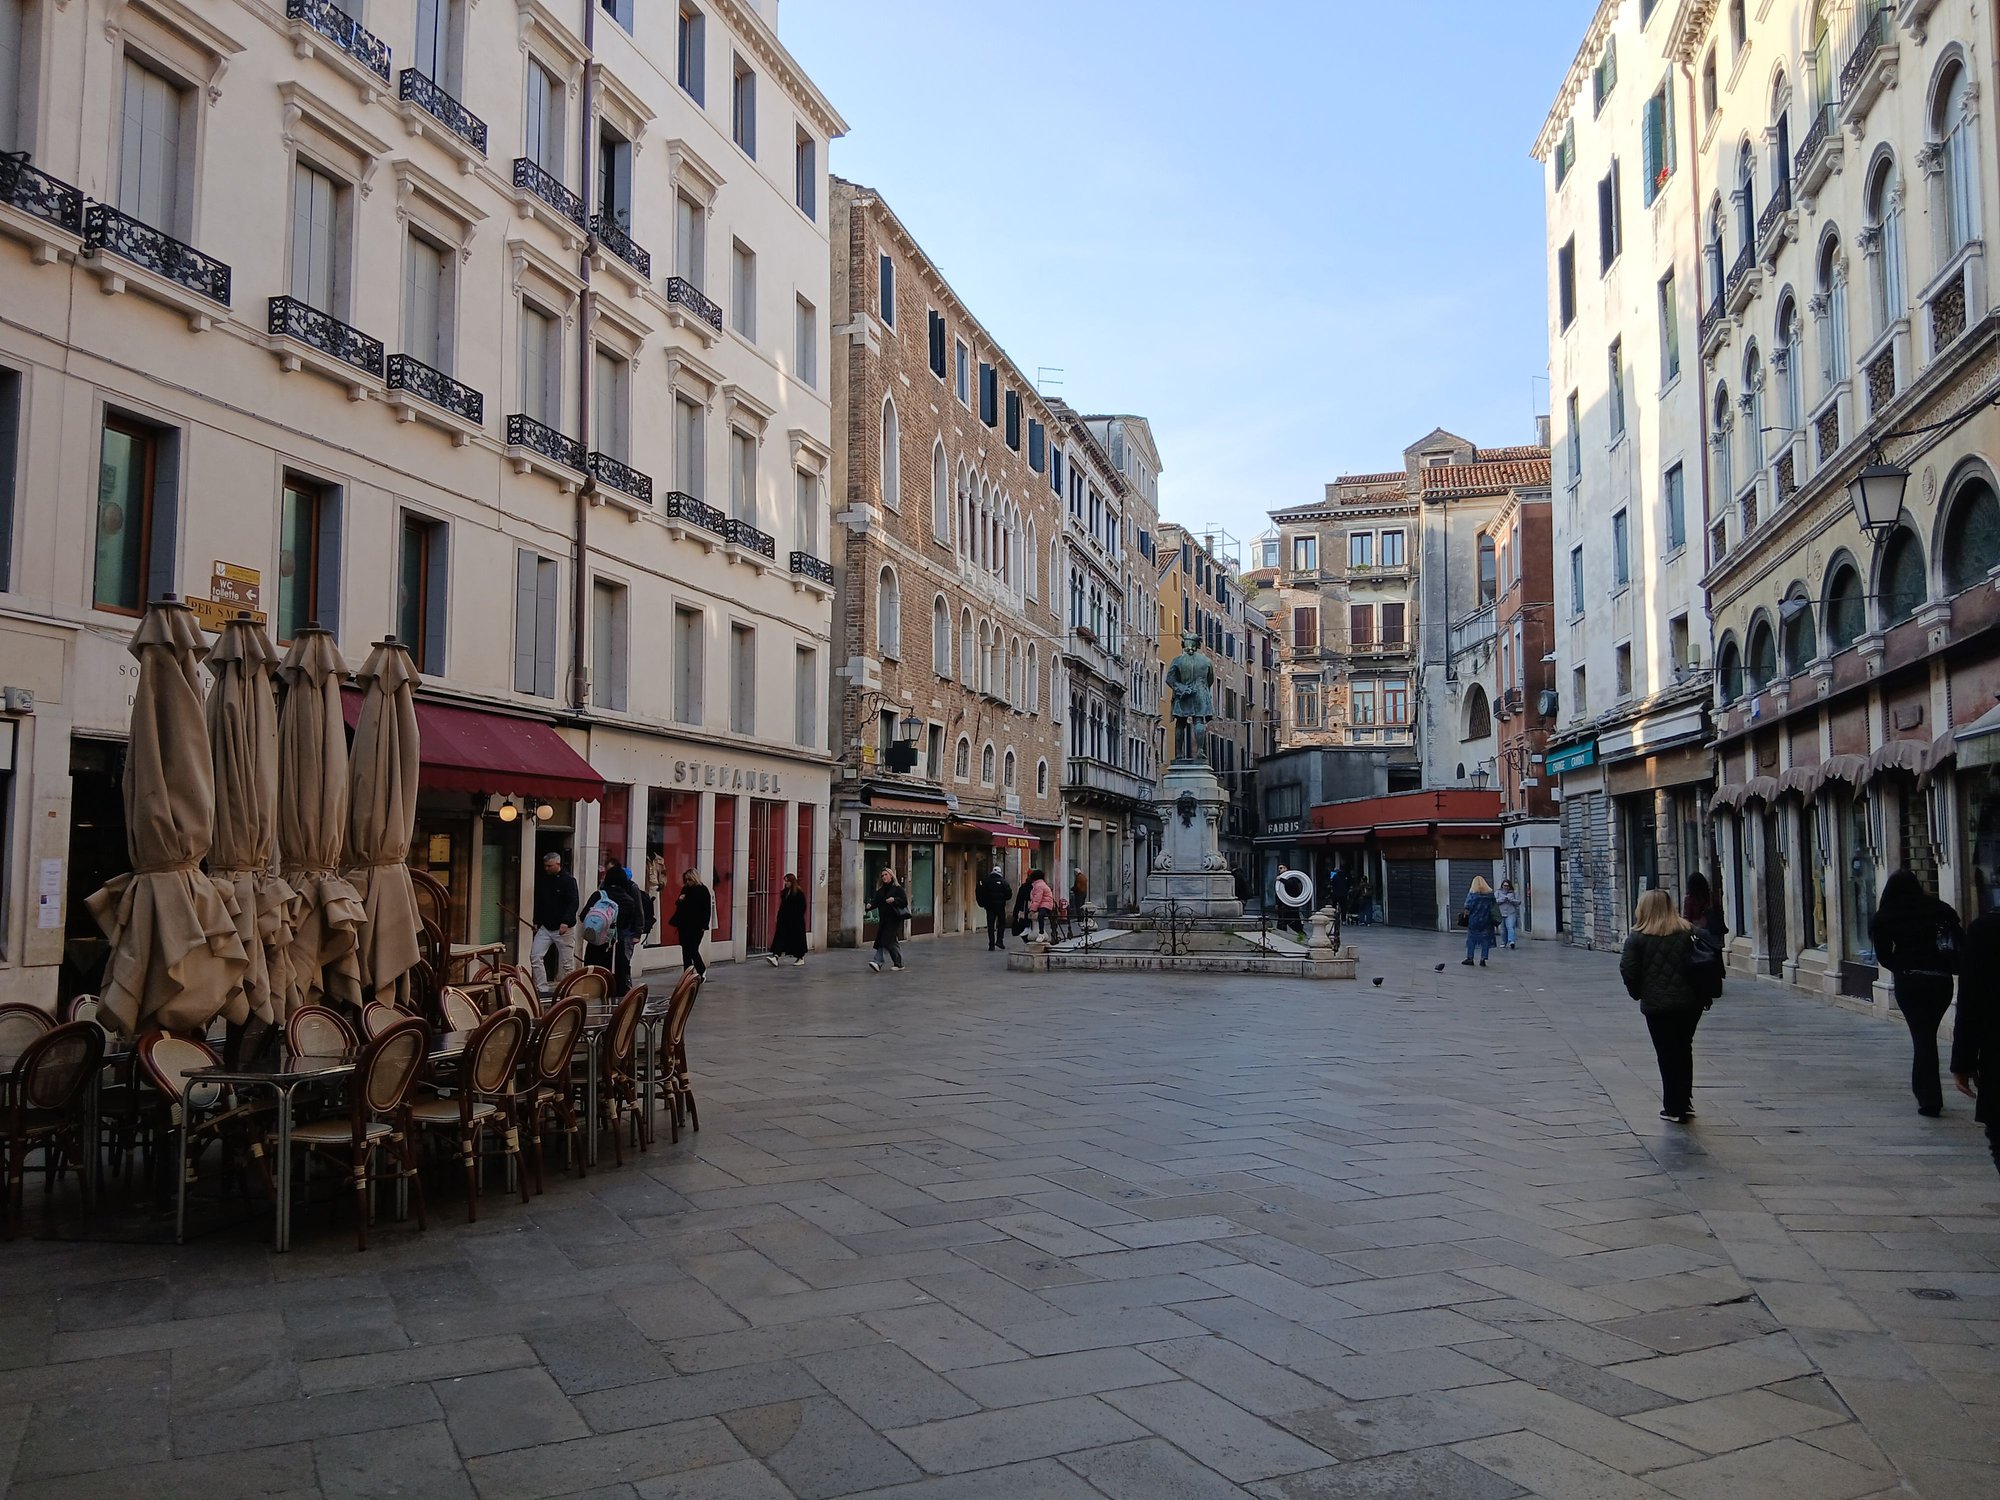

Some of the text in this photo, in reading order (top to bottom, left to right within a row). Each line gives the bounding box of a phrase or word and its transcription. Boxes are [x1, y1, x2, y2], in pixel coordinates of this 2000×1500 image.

[220, 579, 233, 590] WC
[212, 586, 239, 600] toilette
[190, 601, 212, 615] PER
[674, 760, 781, 793] STEFANEL
[868, 819, 903, 834] FARMACIA
[912, 822, 940, 835] MORELLI
[1268, 821, 1299, 834] FABRIS
